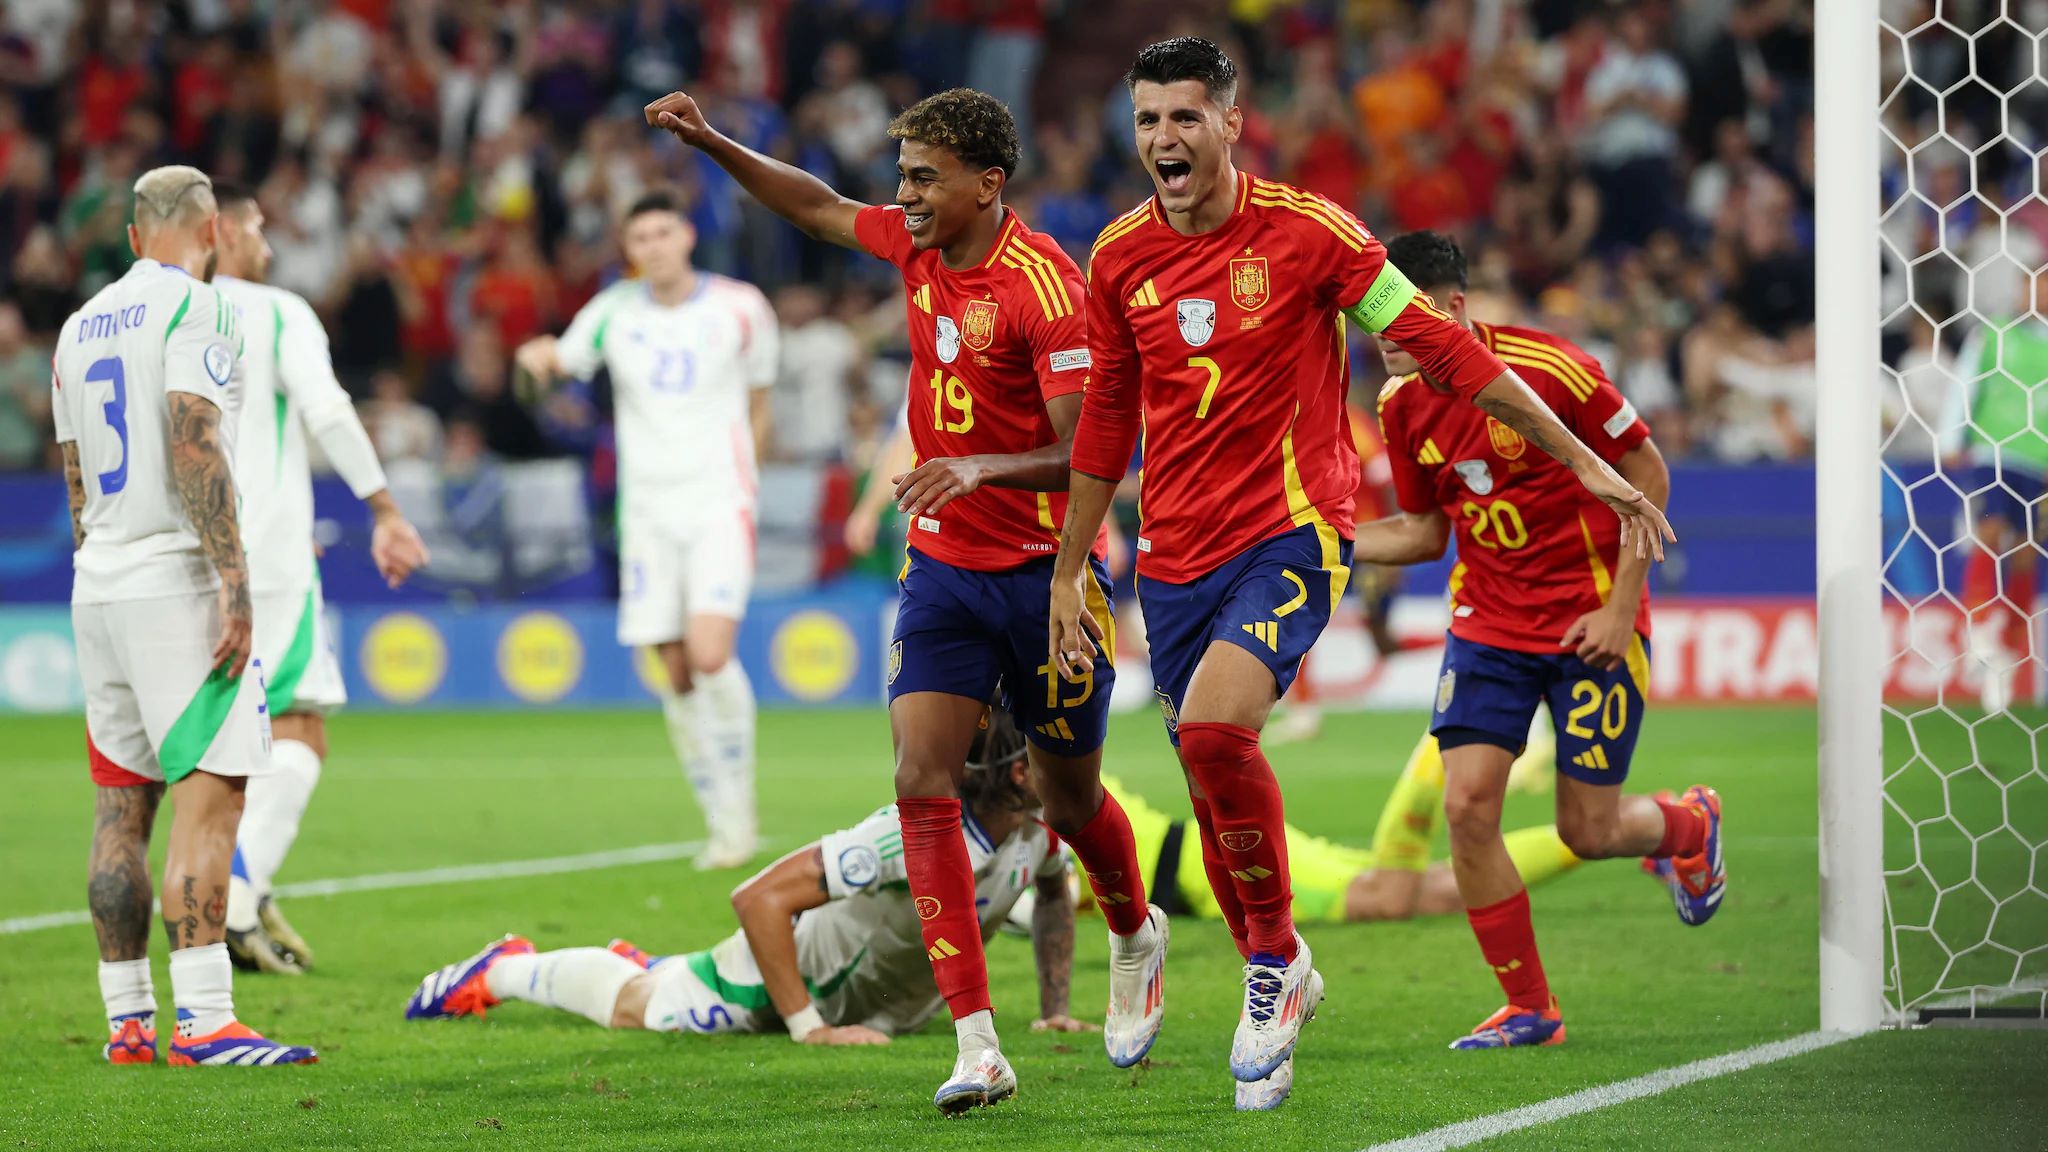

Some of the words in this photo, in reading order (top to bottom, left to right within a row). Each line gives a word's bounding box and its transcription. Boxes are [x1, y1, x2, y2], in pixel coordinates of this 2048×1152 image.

[1369, 275, 1402, 312] RESPEC
[930, 369, 975, 434] 19
[1188, 357, 1222, 419] 7
[85, 356, 128, 495] 3
[1462, 499, 1529, 549] 20
[1272, 568, 1308, 618] 7
[1037, 650, 1094, 709] 19
[1565, 679, 1627, 740] 20
[689, 1005, 732, 1030] 5
